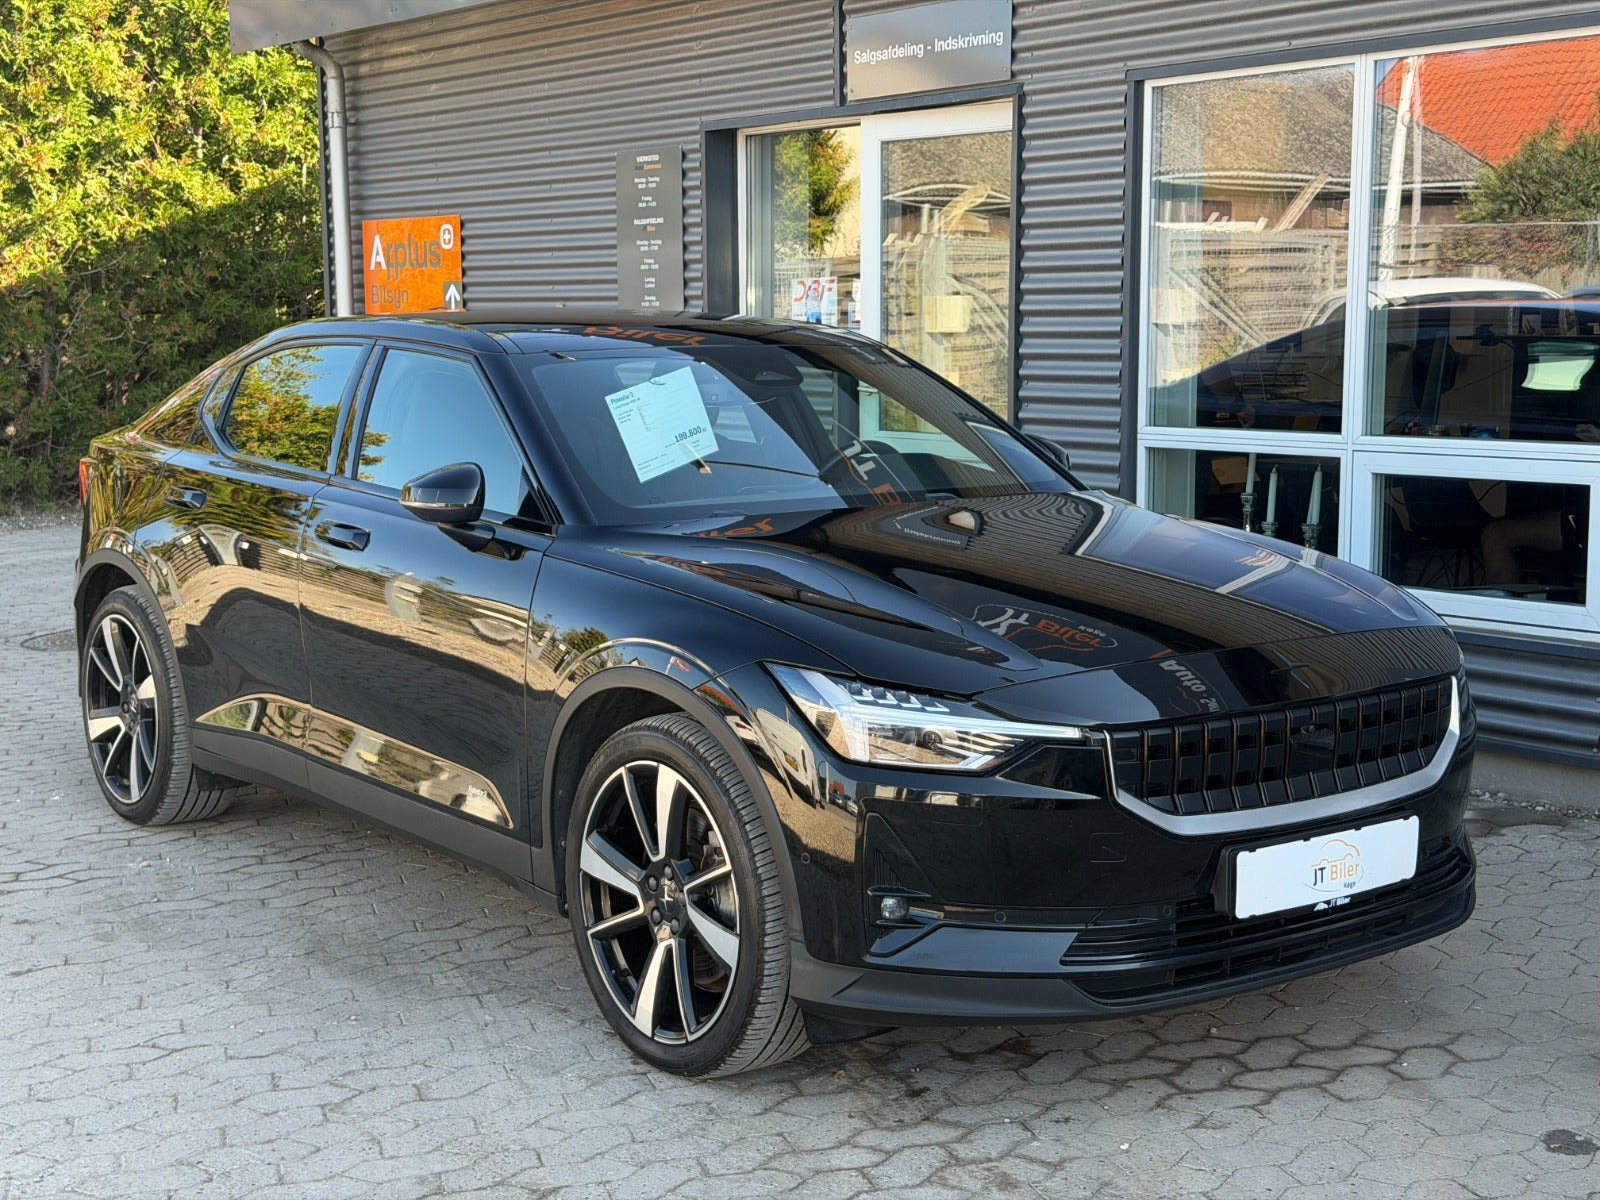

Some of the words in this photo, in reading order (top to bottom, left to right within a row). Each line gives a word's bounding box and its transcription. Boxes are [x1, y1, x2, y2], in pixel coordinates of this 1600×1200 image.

[853, 43, 924, 65] Salgsafdeling
[934, 30, 1004, 53] Indskrivning
[371, 284, 409, 309] Bilsyn
[675, 425, 702, 443] 199.800
[1312, 866, 1326, 886] JT
[1330, 861, 1359, 880] Biler
